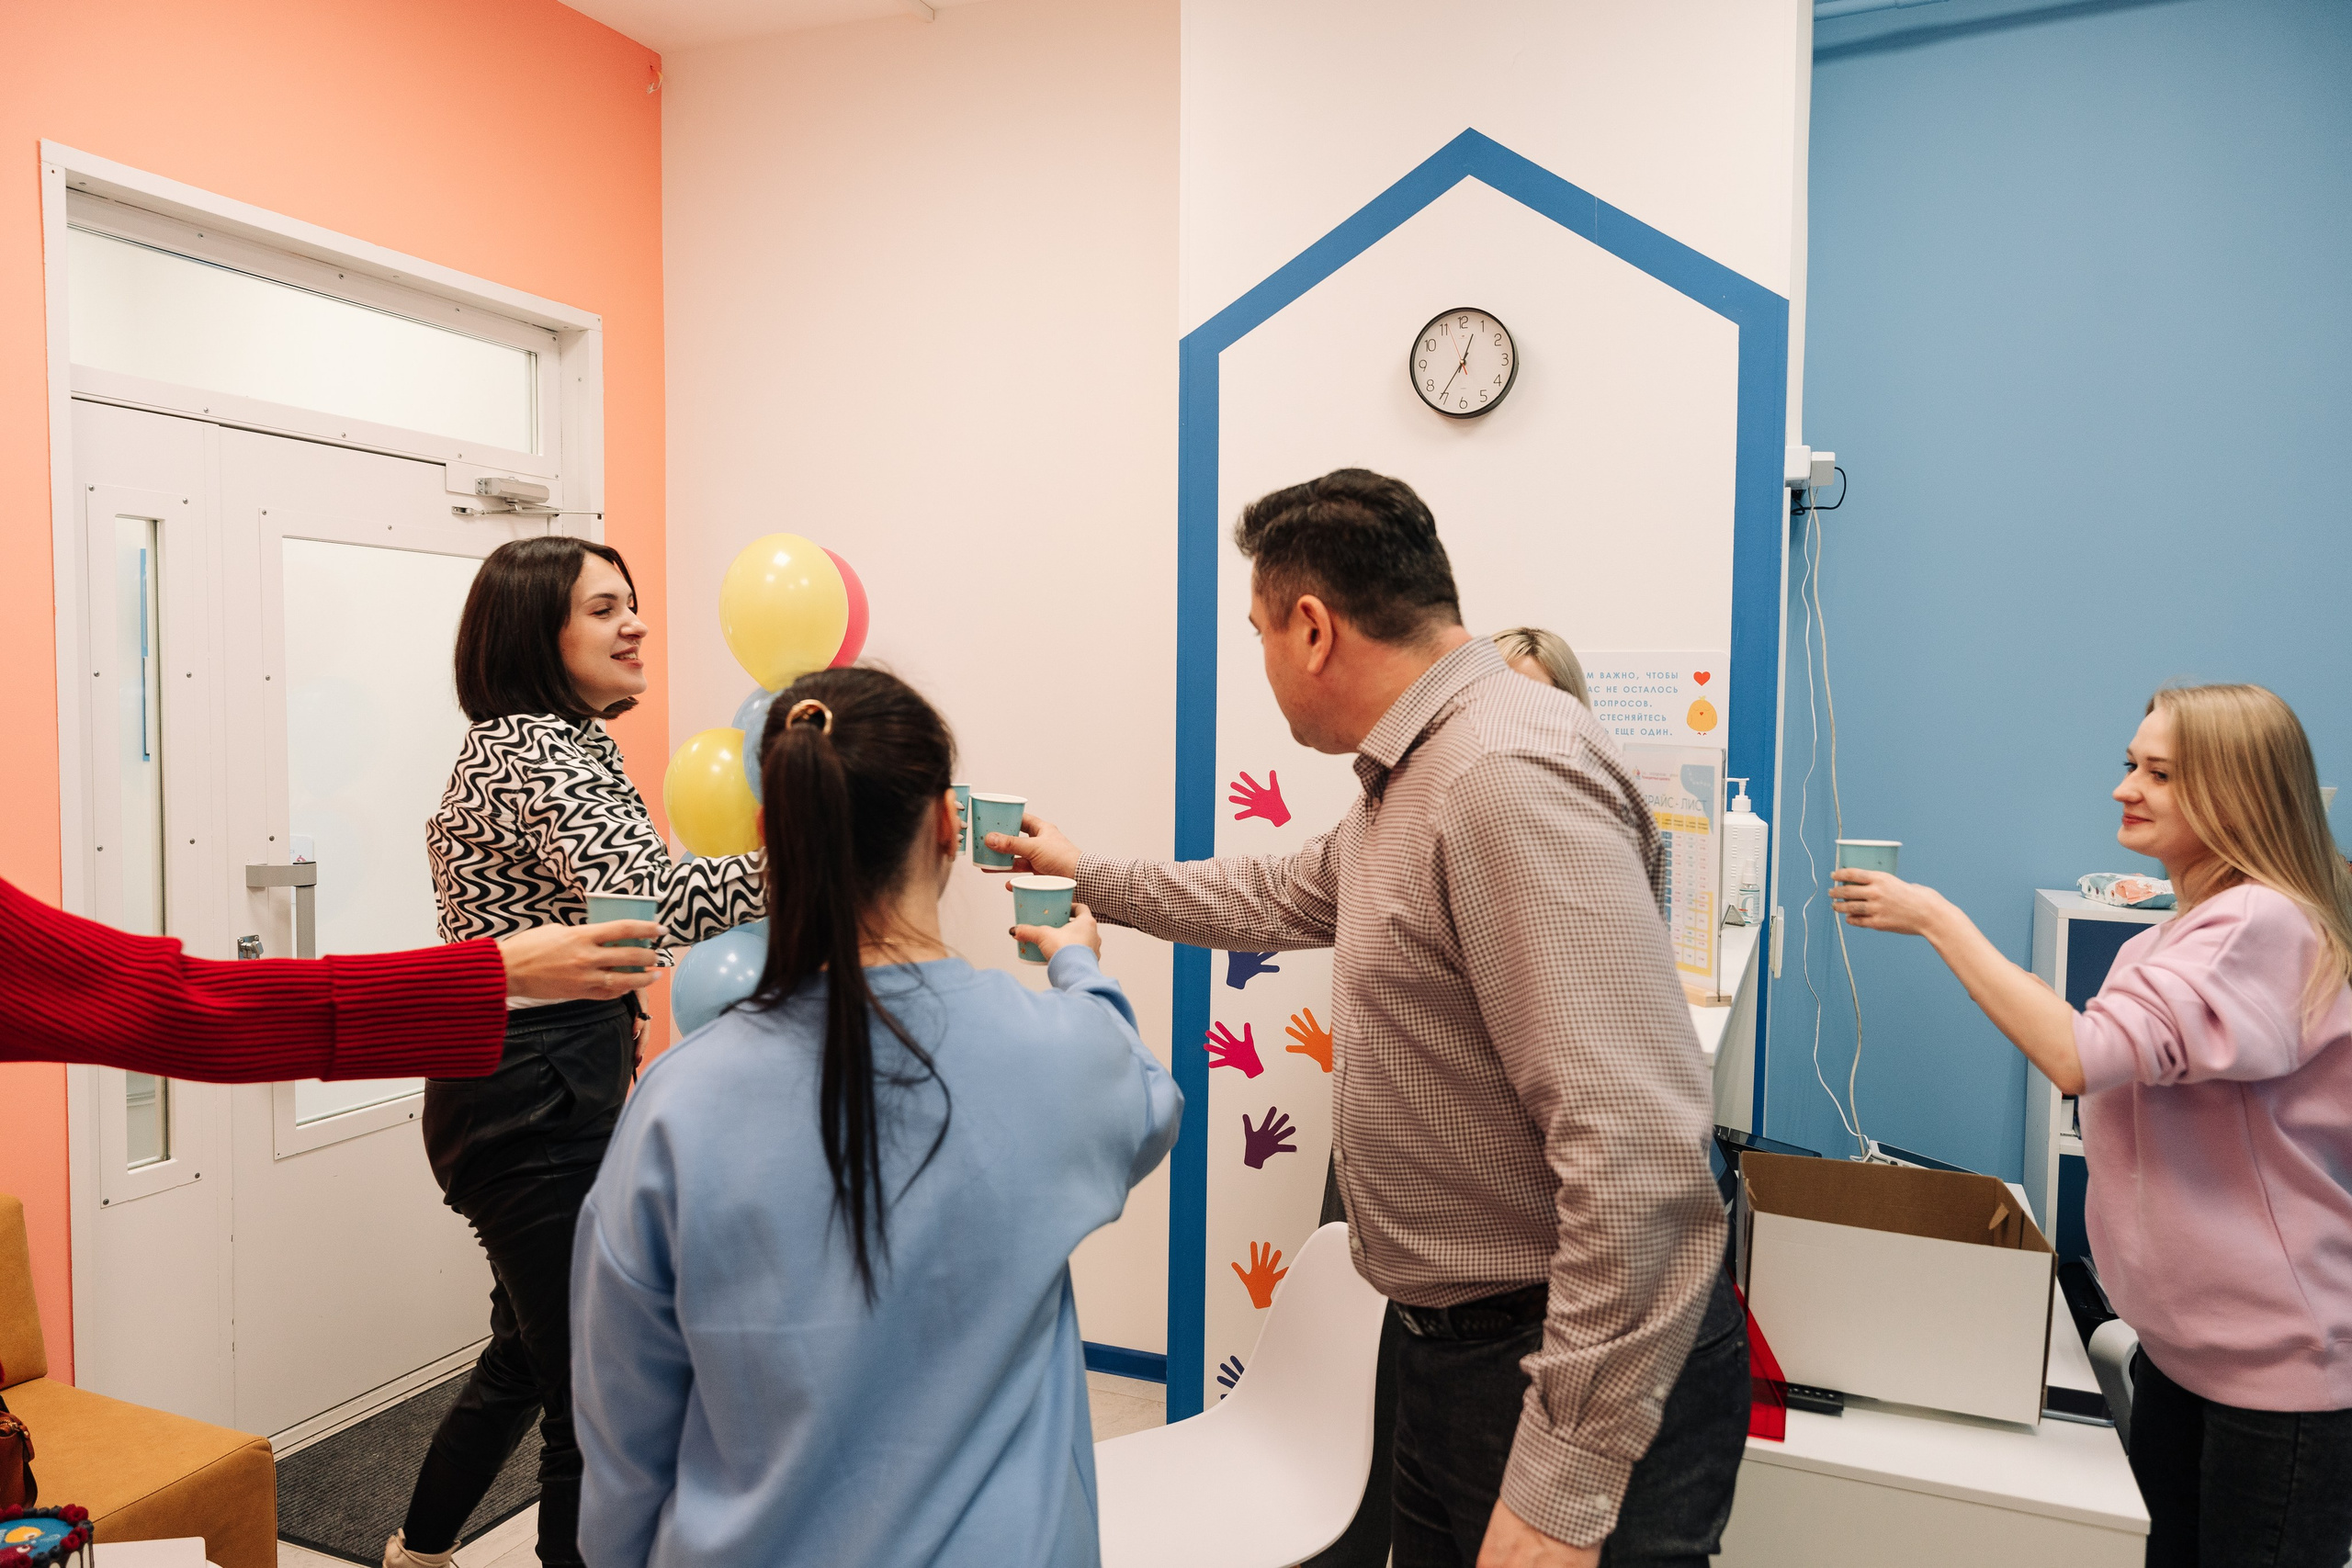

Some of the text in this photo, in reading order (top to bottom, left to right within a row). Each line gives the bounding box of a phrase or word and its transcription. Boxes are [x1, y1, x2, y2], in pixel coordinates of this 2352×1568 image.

[1458, 315, 1469, 329] 12
[1480, 320, 1485, 333] 1
[1440, 323, 1448, 336] 11
[1425, 338, 1437, 352] 10
[1494, 333, 1502, 346] 2
[1419, 359, 1428, 372] 9
[1501, 353, 1510, 367] 3
[1426, 378, 1435, 391] 8
[1493, 374, 1502, 387] 4
[1441, 391, 1449, 405] 7
[1479, 389, 1488, 402] 5
[1459, 397, 1468, 410] 6
[1600, 671, 1640, 681] ВАЖНО,
[1645, 671, 1679, 680] ЧТОБЫ
[1588, 685, 1600, 694] АС
[1623, 685, 1679, 694] ОСТАЛОСЬ
[1600, 712, 1667, 722] СТЕСНЯЙТЕСЬ
[1615, 728, 1635, 736] ЕЩЕ
[1640, 728, 1673, 736] ОДИН.
[1680, 797, 1707, 811] ЛИСТ
